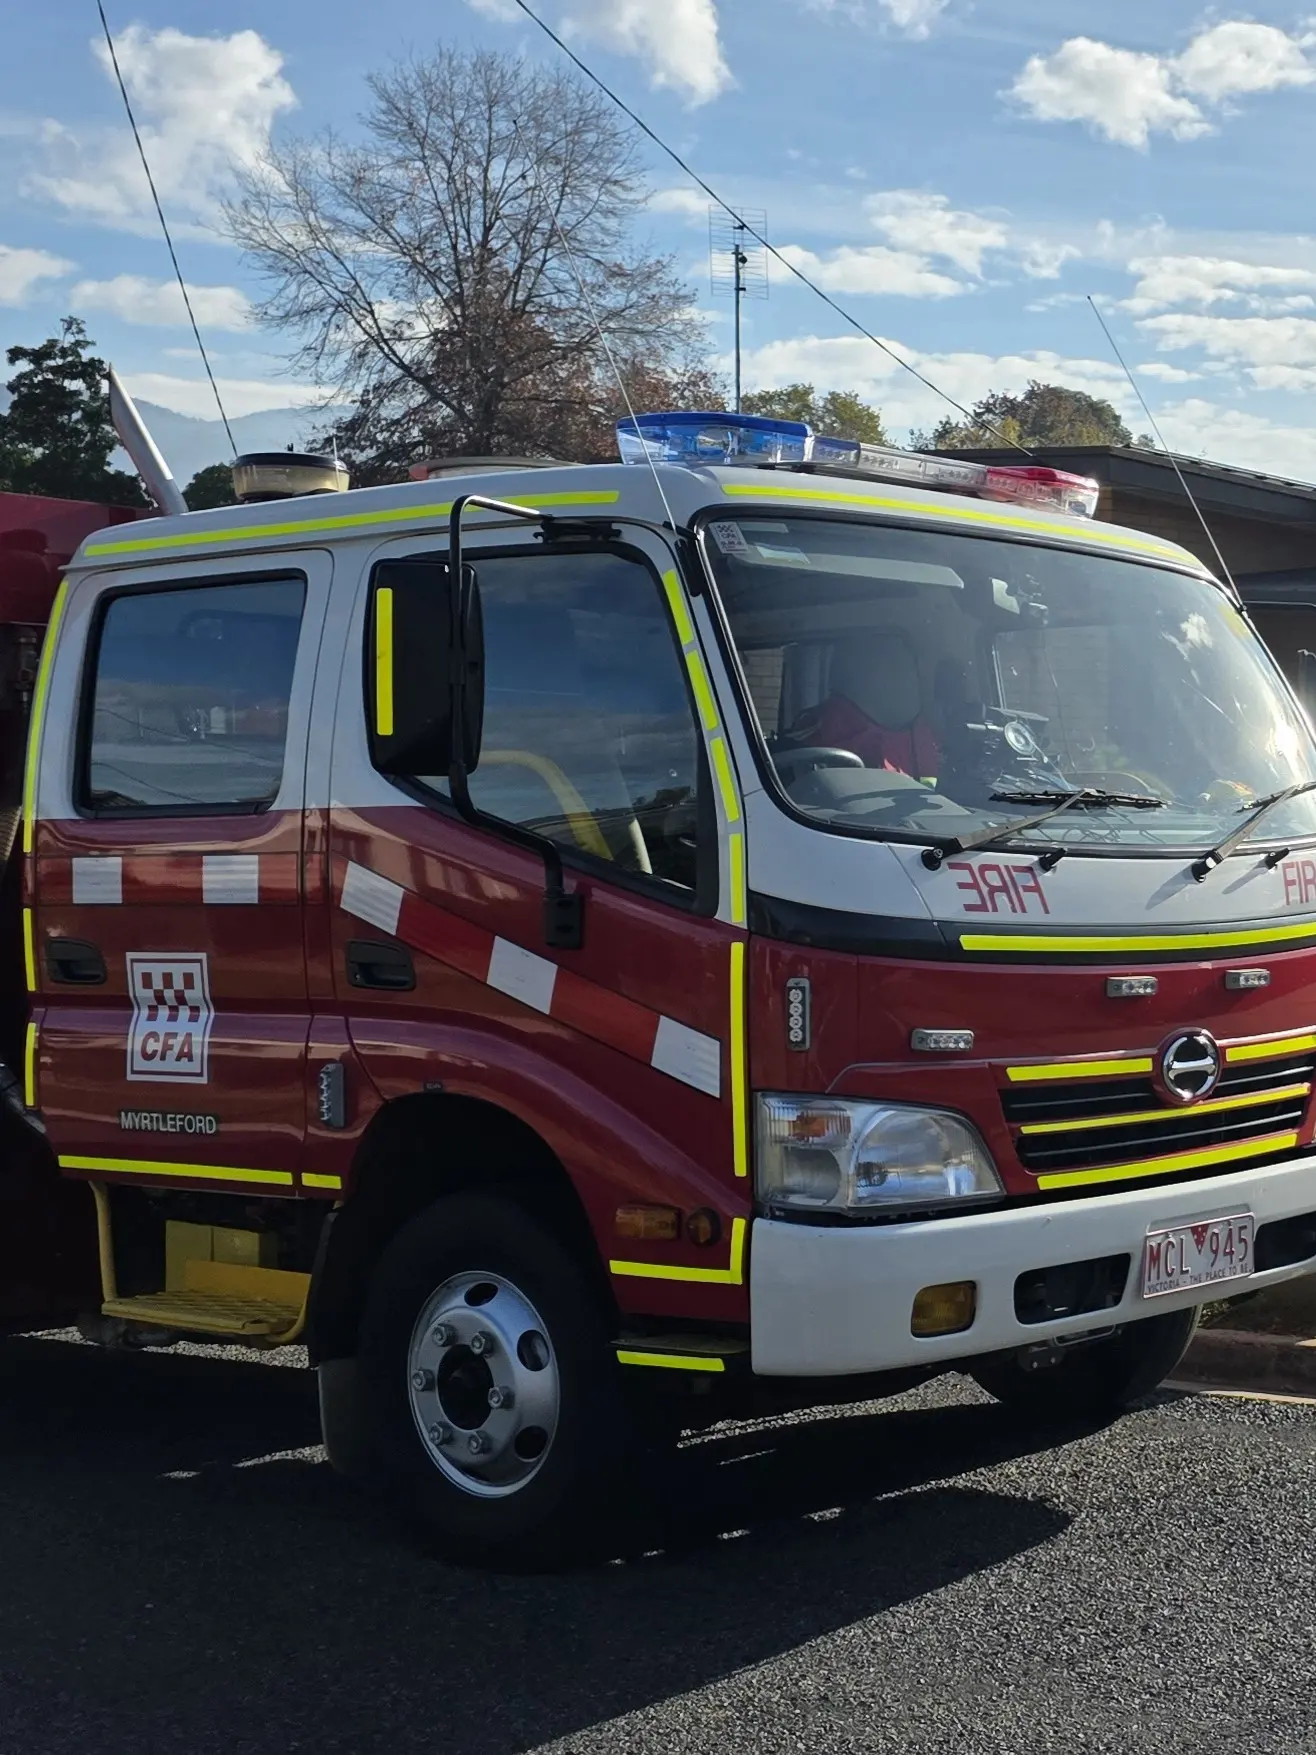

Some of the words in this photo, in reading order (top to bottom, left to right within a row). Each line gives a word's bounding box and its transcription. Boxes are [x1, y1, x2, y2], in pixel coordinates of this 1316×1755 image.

[140, 1031, 194, 1062] CFA
[120, 1111, 217, 1134] MYRTLEFORD
[1148, 1234, 1191, 1282] MCL
[1210, 1224, 1248, 1267] 945
[1147, 1278, 1180, 1292] VICTORIA
[1190, 1273, 1202, 1284] THE
[1206, 1268, 1226, 1280] PLACE
[1229, 1266, 1237, 1276] TO
